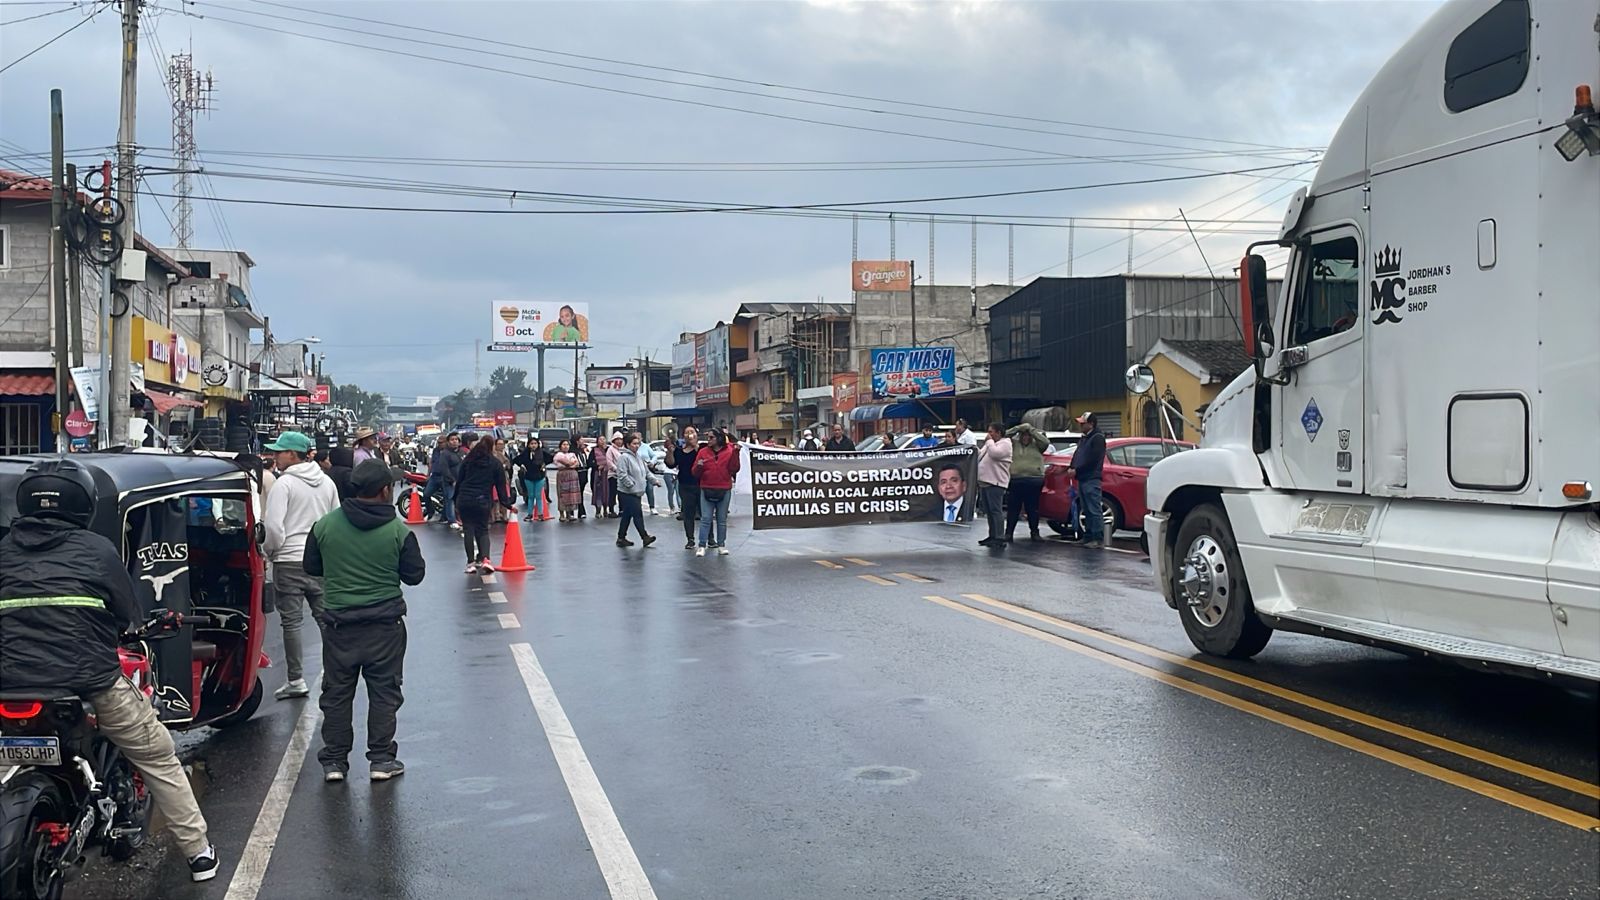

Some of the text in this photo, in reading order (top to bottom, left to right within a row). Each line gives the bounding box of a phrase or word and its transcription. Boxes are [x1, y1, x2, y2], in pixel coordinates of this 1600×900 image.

[1370, 277, 1406, 311] MC
[1408, 284, 1437, 296] BARBER
[1408, 301, 1428, 312] SHOP
[507, 326, 535, 336] 8 oct.
[875, 348, 952, 373] CAR WASH
[906, 371, 941, 380] AMIGOS
[599, 380, 623, 390] LTH
[65, 418, 89, 428] Claro
[904, 450, 925, 459] dice
[935, 447, 974, 457] ministro
[754, 467, 933, 485] NEGOCIOS CERRADOS
[756, 484, 934, 500] ECONOMÍA LOCAL AFECTADA
[757, 499, 910, 517] FAMILIAS EN CRISIS
